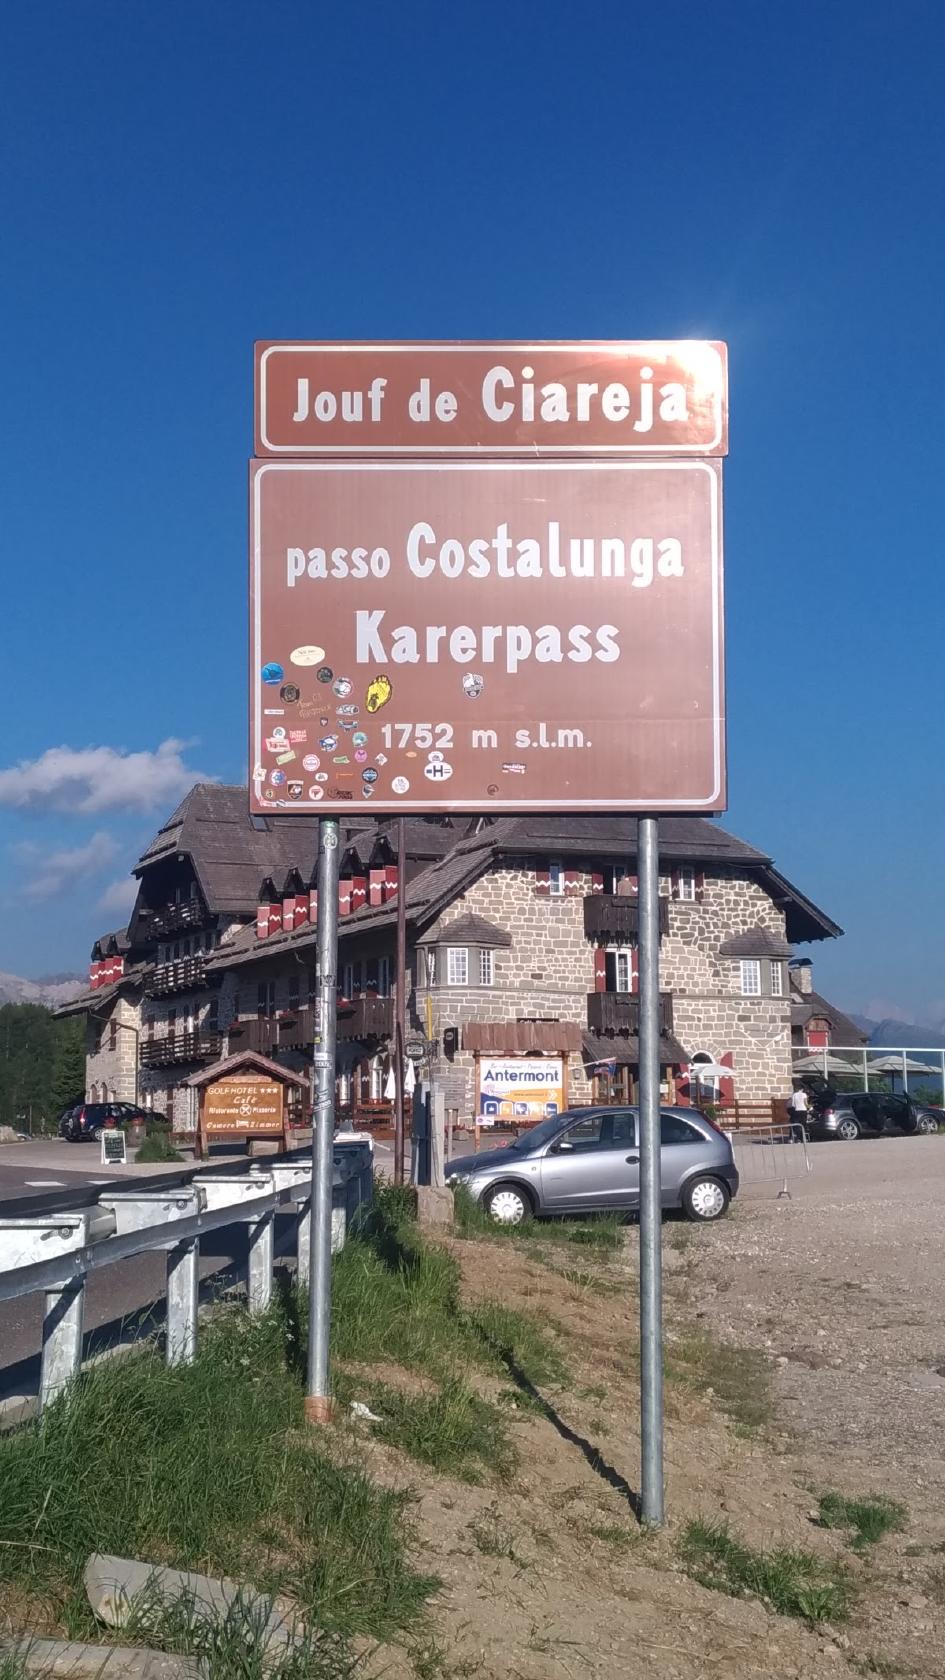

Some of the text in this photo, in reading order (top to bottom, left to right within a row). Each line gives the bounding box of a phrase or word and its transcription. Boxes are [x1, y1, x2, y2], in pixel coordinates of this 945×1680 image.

[293, 366, 690, 432] Jouf de Ciareja
[286, 521, 685, 588] passo Costalunga
[356, 610, 621, 673] Karerpass
[381, 723, 592, 749] 1752 m s.l.m.
[484, 1069, 560, 1083] Antermont
[207, 1087, 258, 1095] GOLF HOTEL
[250, 1121, 280, 1129] Zimmer
